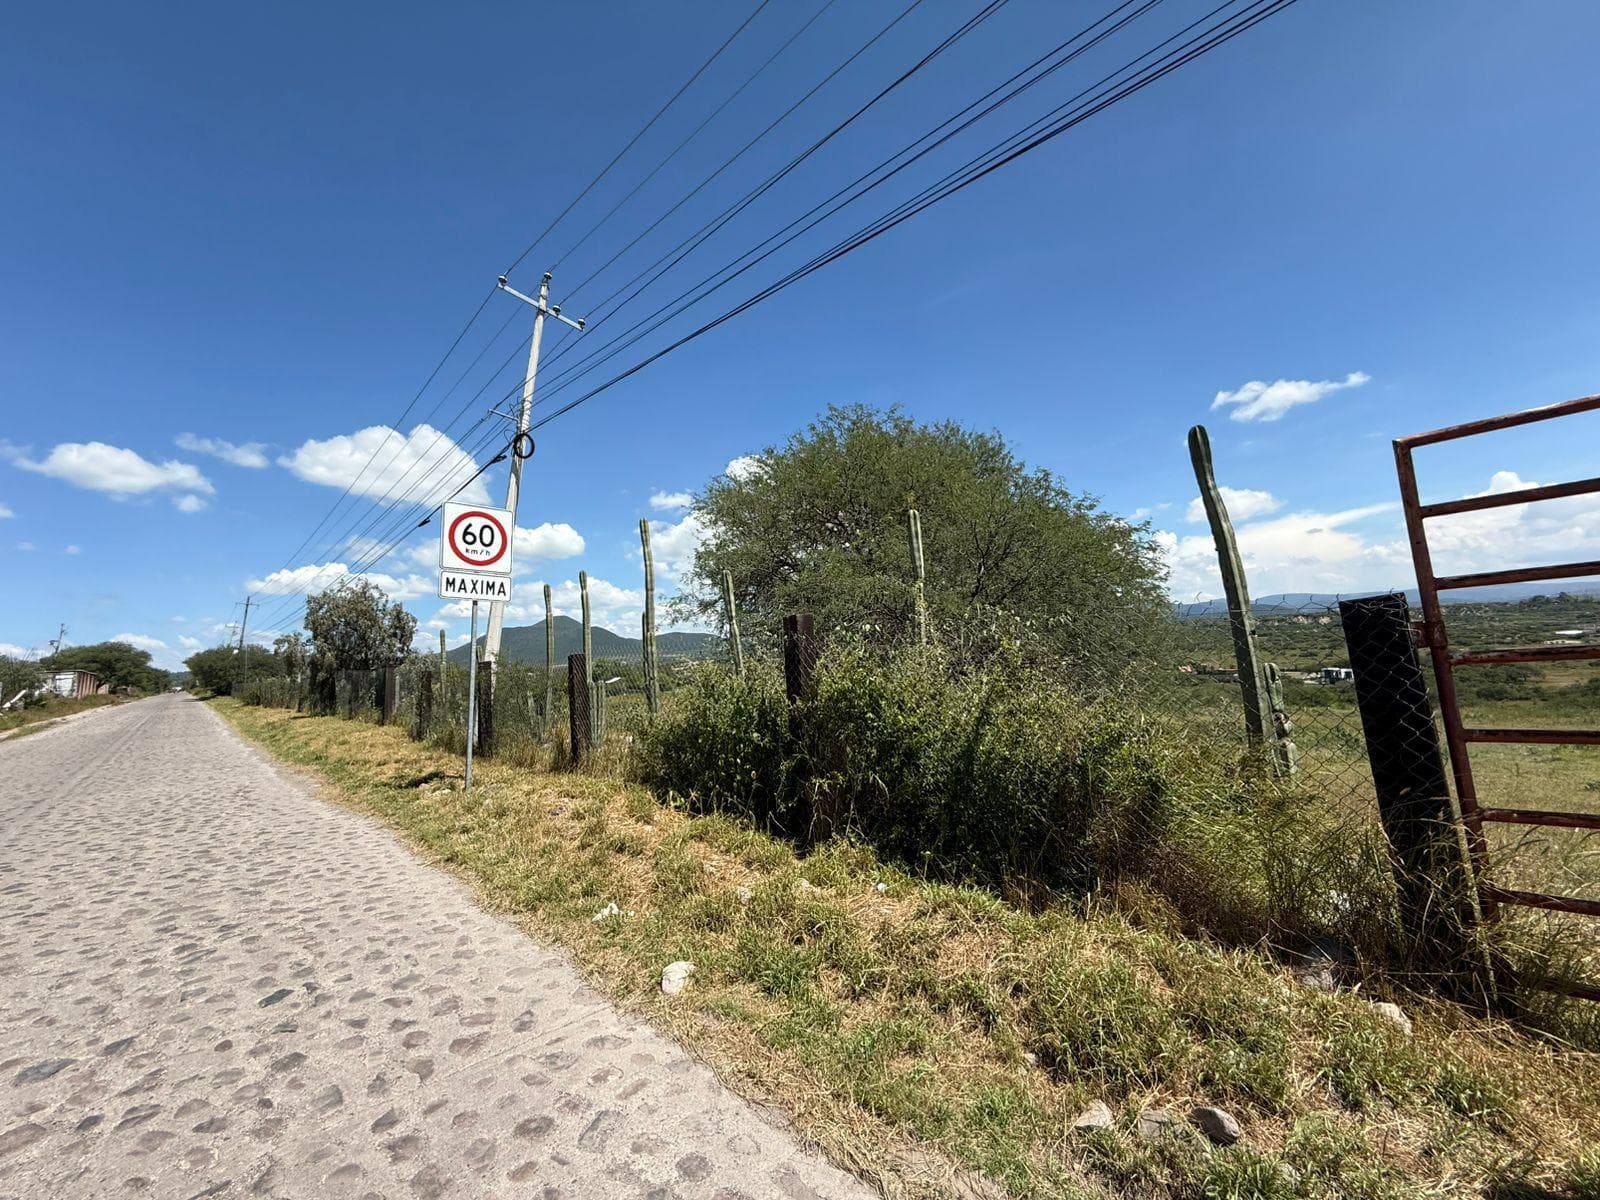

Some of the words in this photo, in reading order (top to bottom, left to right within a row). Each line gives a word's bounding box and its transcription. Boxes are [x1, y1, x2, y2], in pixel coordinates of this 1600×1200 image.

[462, 523, 495, 548] 60
[465, 547, 491, 556] km/h
[445, 576, 507, 597] MAXIMA
